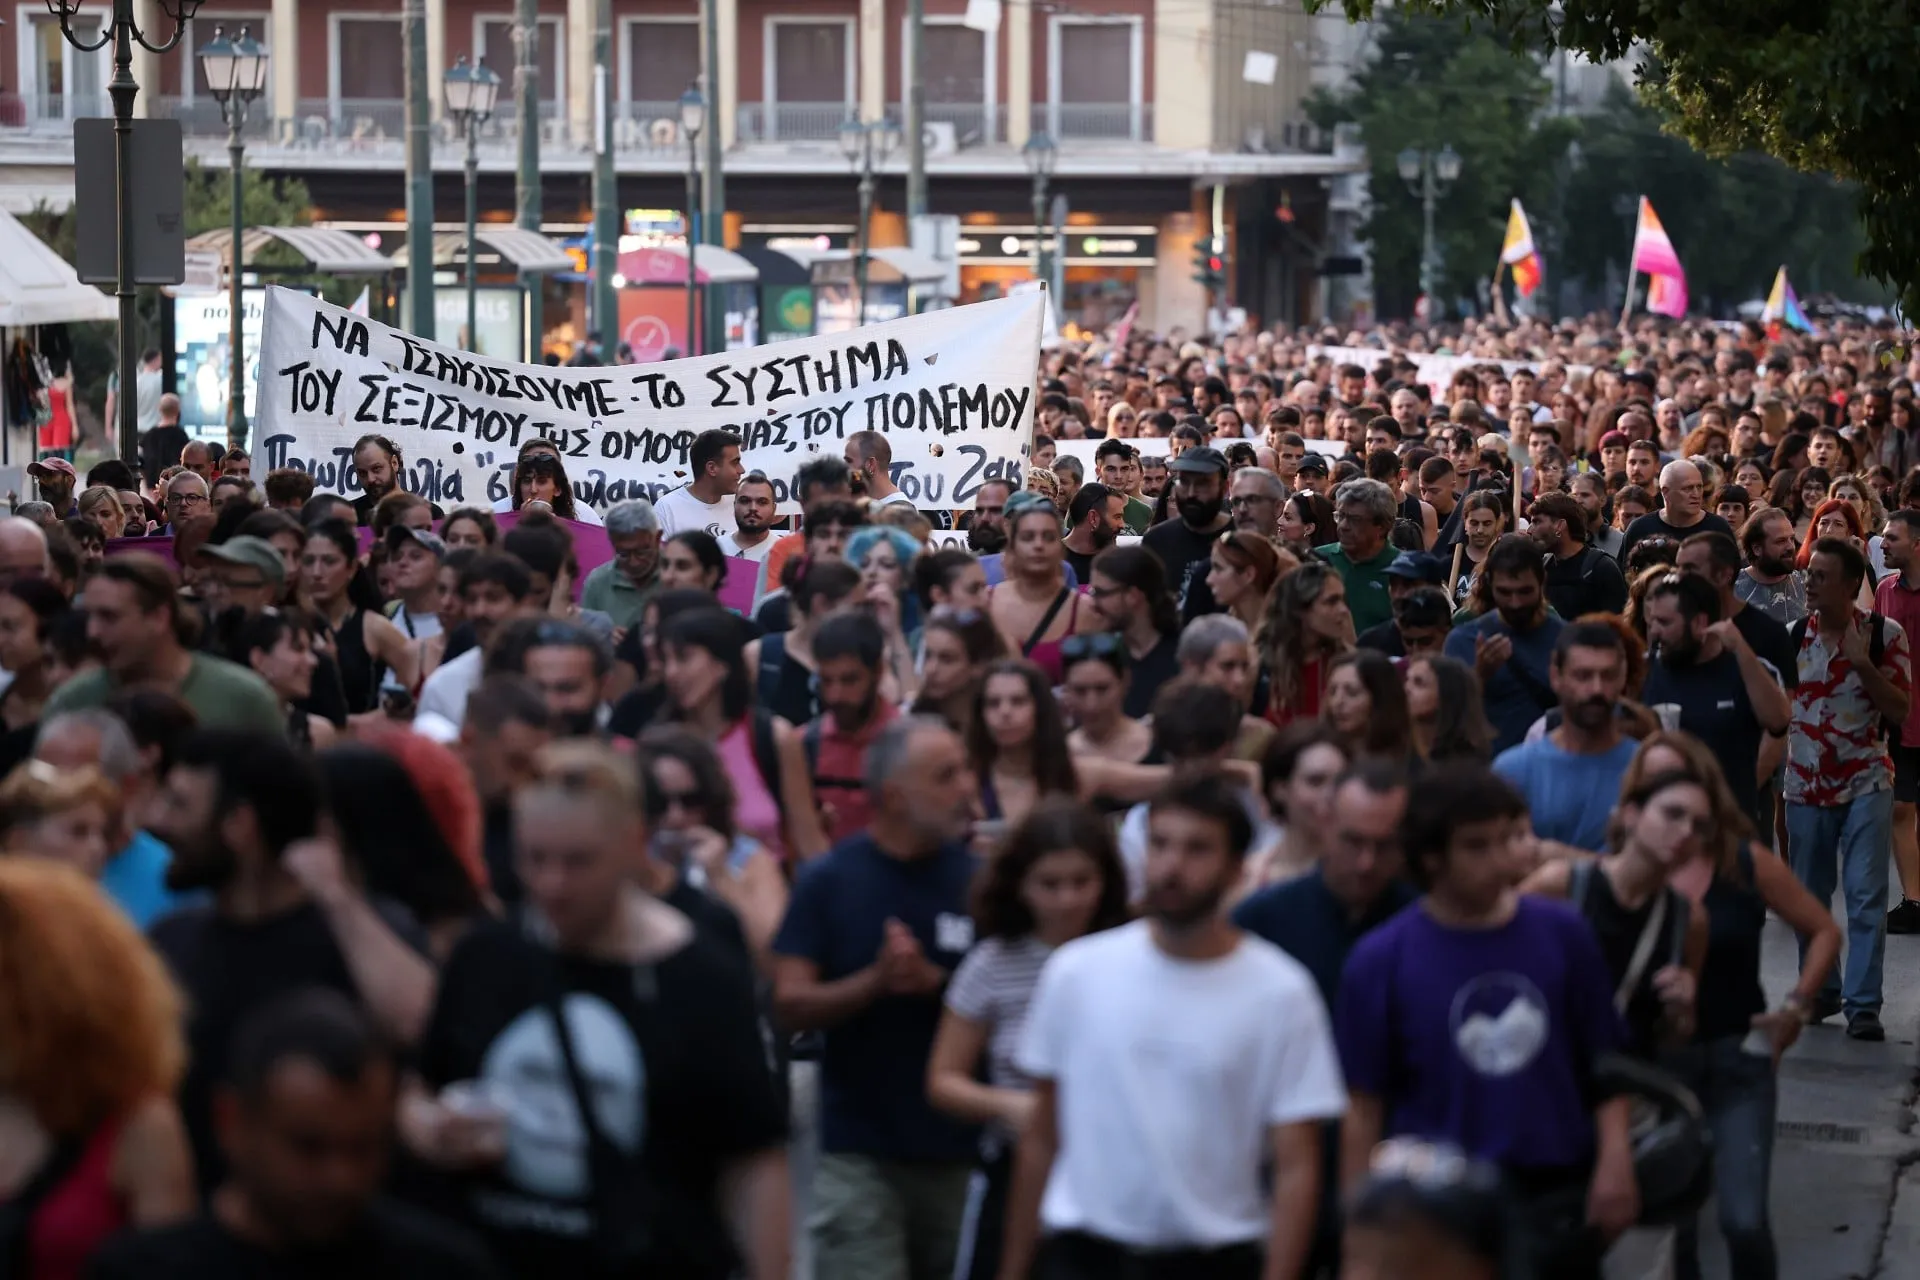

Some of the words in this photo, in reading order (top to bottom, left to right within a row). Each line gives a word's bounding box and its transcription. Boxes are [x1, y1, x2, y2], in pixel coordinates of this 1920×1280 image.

[279, 361, 343, 416] ΤΟΥ
[354, 375, 529, 447] ΣΕΞΙΣΜΟΥ
[532, 421, 592, 458] ΤΗΣ
[601, 412, 798, 466] ΟΜΟΦΙΑΣ,
[796, 400, 855, 440] ΤΟΥ
[865, 382, 1030, 435] ΠΟΛΕΜΟΥ
[312, 311, 370, 357] ΝΑ
[389, 333, 624, 418] ΤΣΑΚΙΣΟΥΜΕ
[706, 338, 909, 408] ΣΥΣΤΗΜΑ
